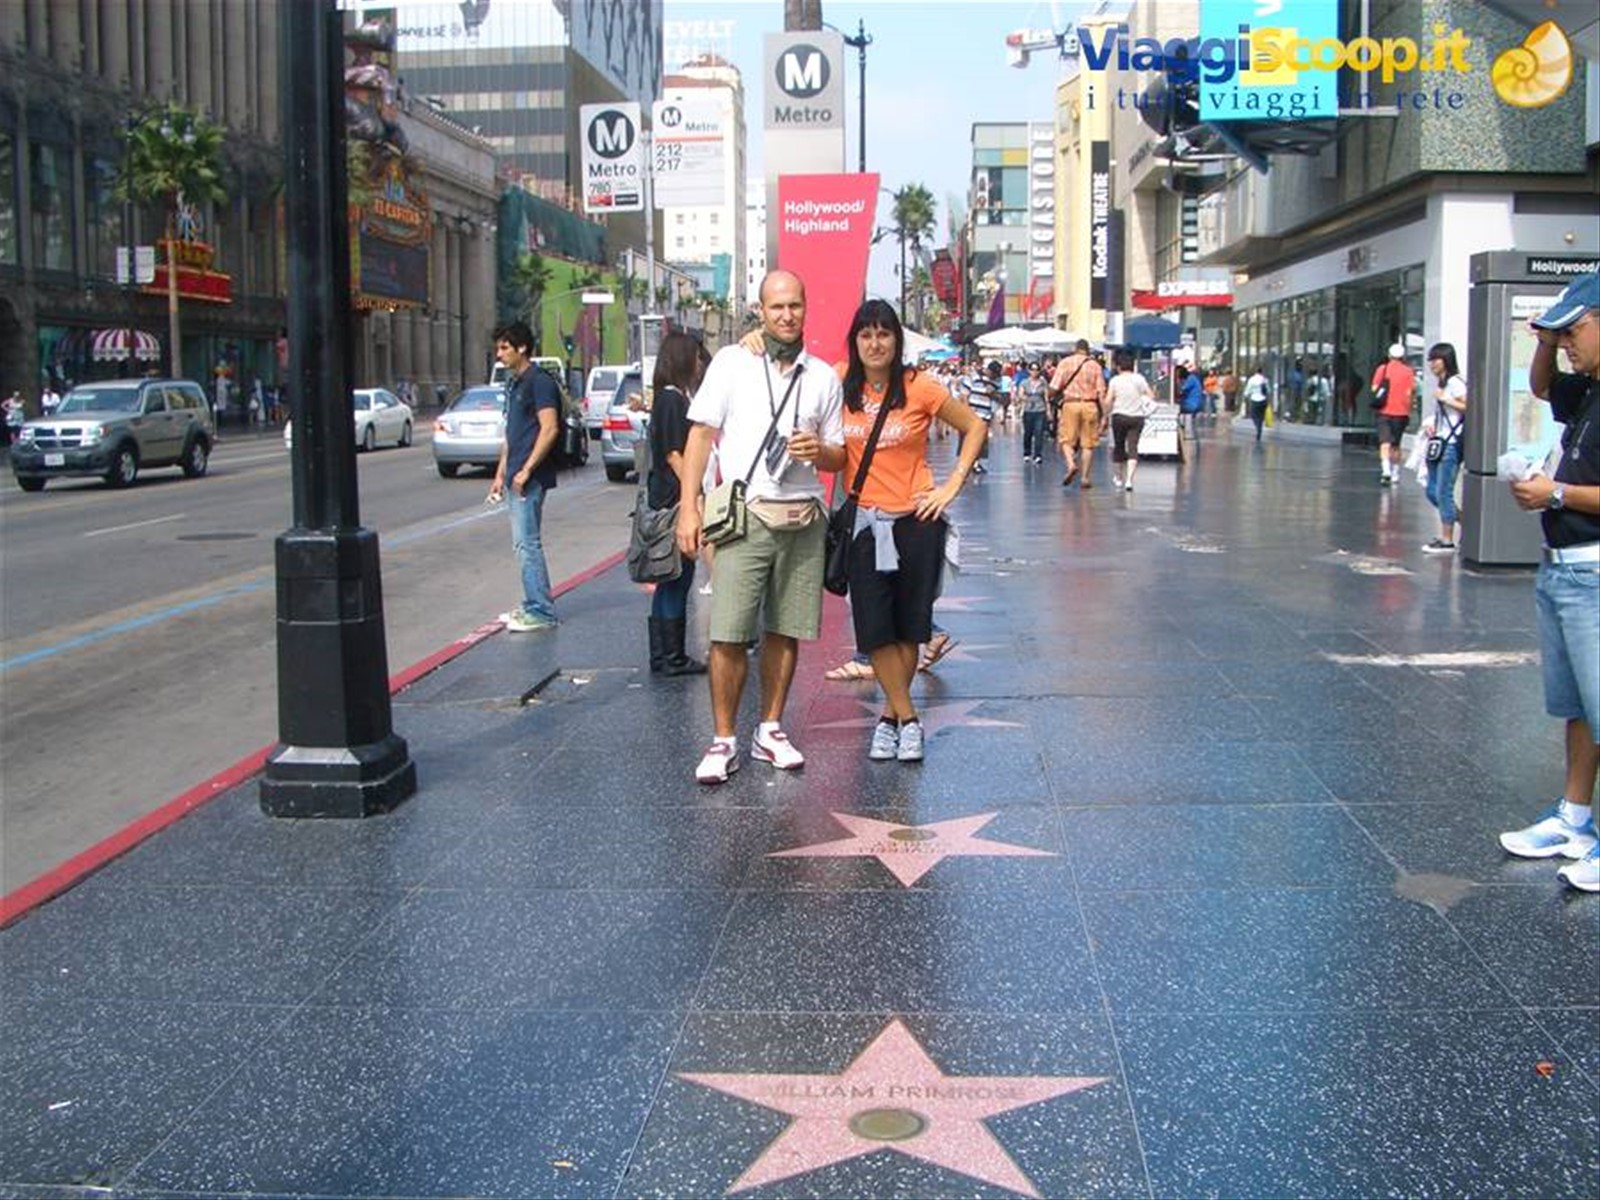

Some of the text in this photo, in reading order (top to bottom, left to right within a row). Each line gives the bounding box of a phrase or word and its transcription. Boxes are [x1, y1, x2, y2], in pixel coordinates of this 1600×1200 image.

[774, 105, 833, 124] Metro
[684, 121, 720, 132] Metro
[656, 143, 683, 157] 212
[587, 163, 637, 178] Metro
[656, 159, 682, 172] 217
[784, 200, 865, 217] Hollywood/
[784, 218, 849, 235] Highland
[1092, 172, 1109, 279] Kodak THEATRE
[888, 1085, 1026, 1099] PRIMROSE
